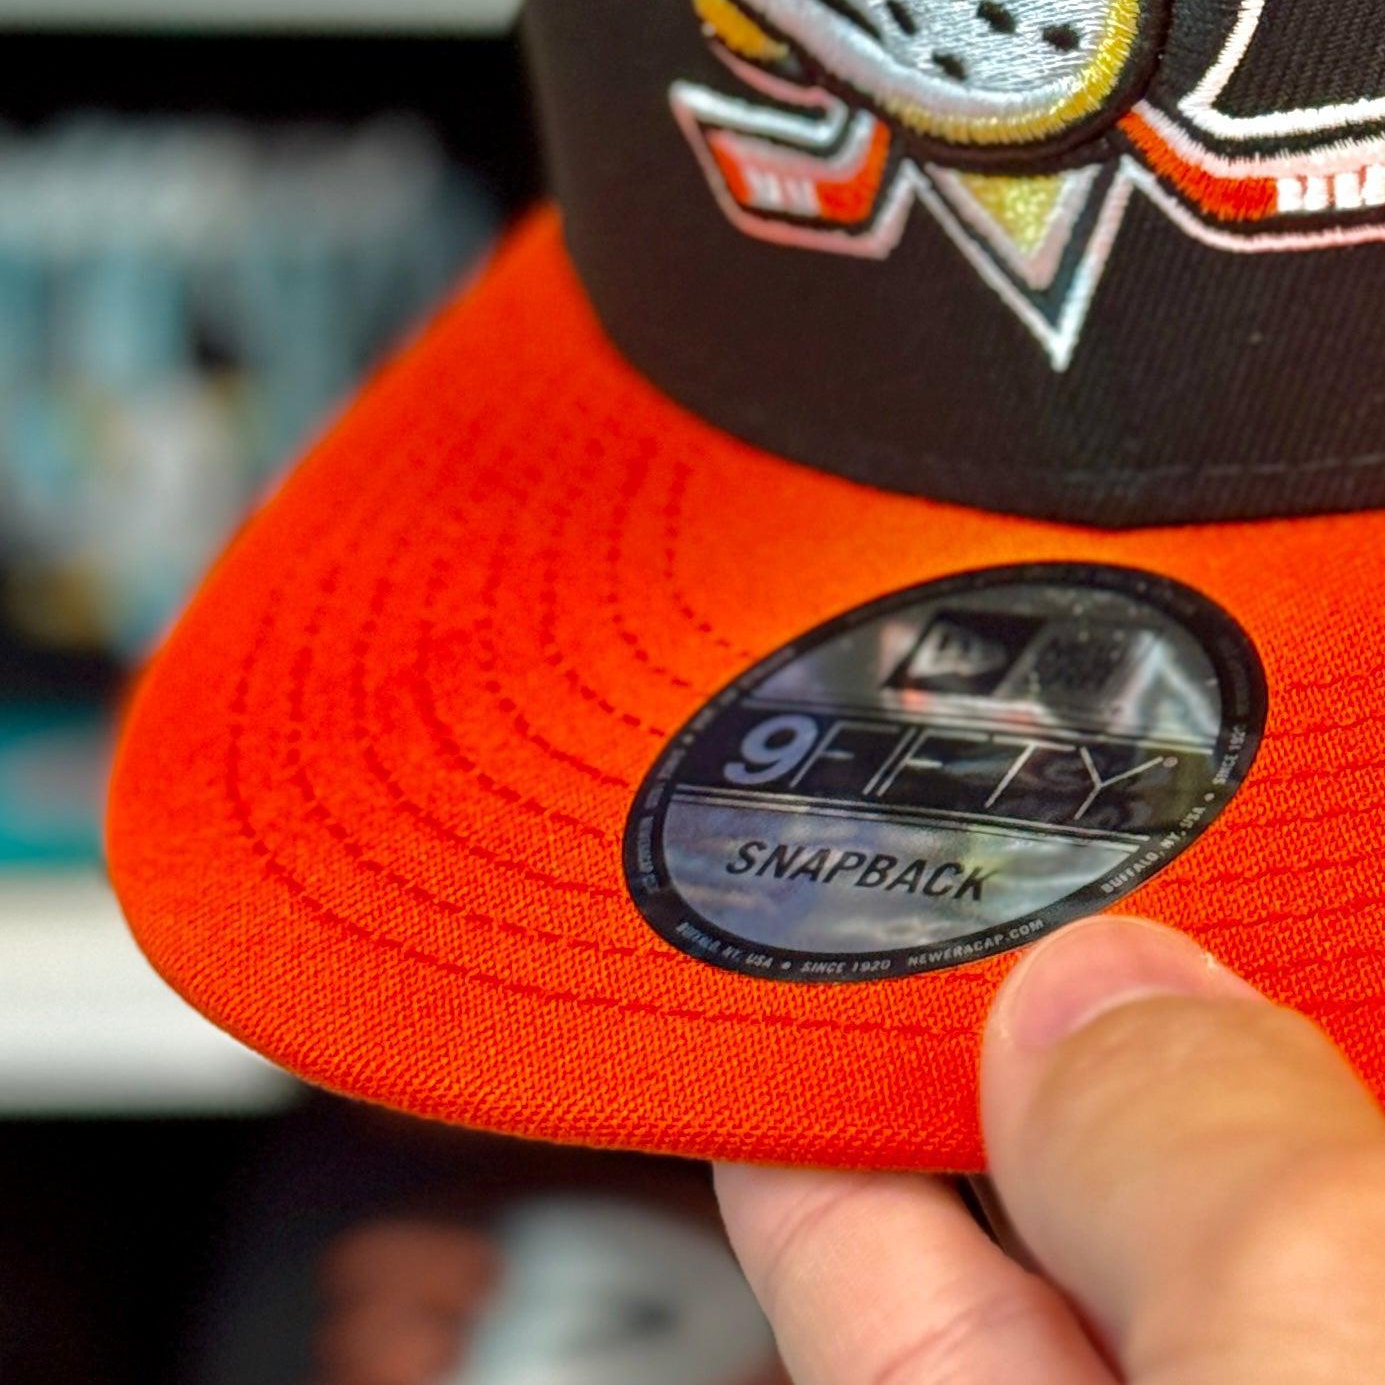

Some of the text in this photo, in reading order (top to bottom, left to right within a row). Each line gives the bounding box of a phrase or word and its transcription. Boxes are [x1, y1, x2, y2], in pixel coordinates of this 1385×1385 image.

[1179, 806, 1206, 830] USA
[725, 840, 998, 902] SNAPBACK
[744, 952, 774, 970] USA
[800, 961, 846, 975] SINCE
[852, 959, 892, 974] 1920
[906, 917, 1045, 968] NEWERACAP.COM
